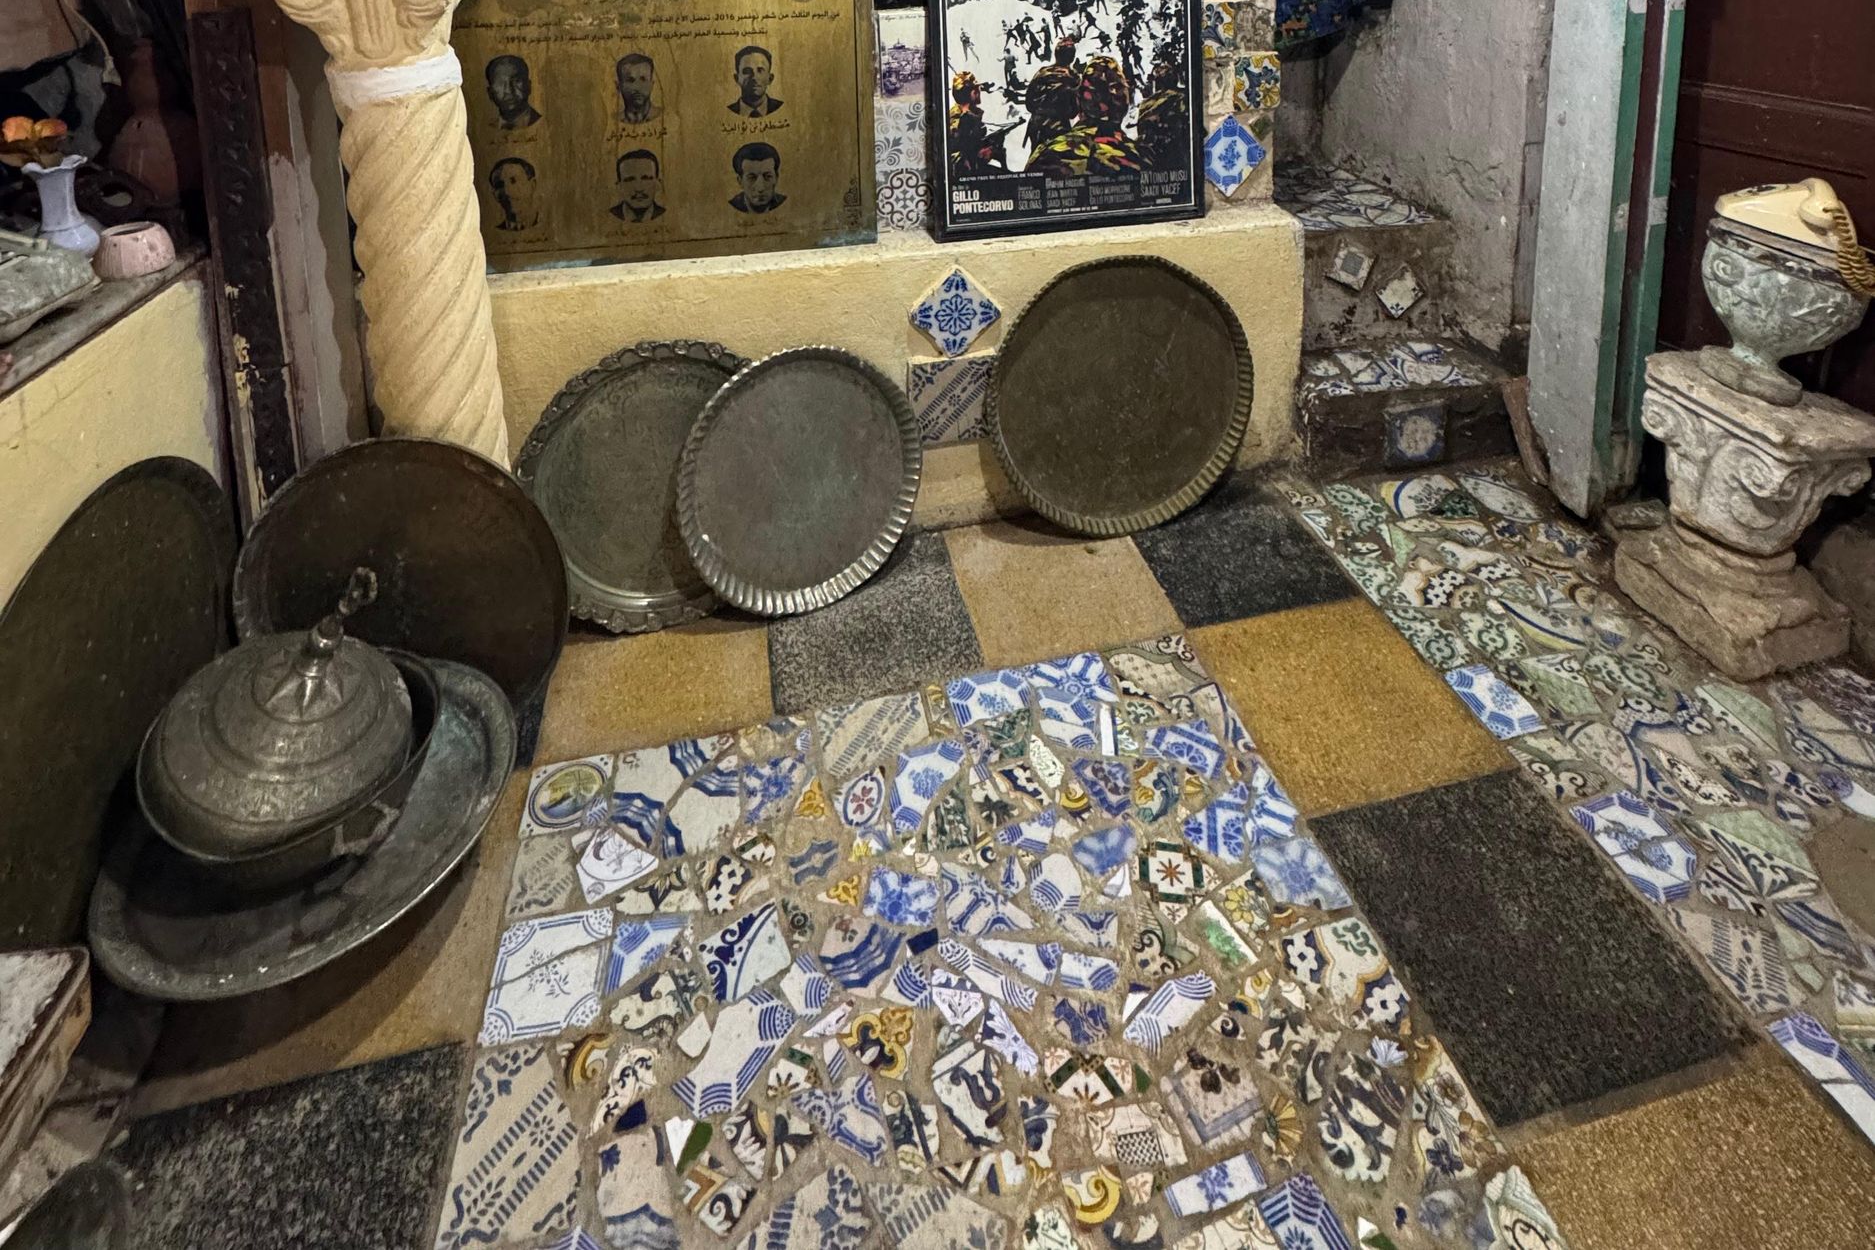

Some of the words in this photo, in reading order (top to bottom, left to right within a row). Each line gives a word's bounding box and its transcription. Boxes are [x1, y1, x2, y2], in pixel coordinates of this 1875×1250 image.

[1140, 170, 1169, 184] ANTONIO
[952, 189, 980, 203] GILLO
[1160, 182, 1181, 196] YACEF
[952, 199, 1014, 215] PONTECORVO
